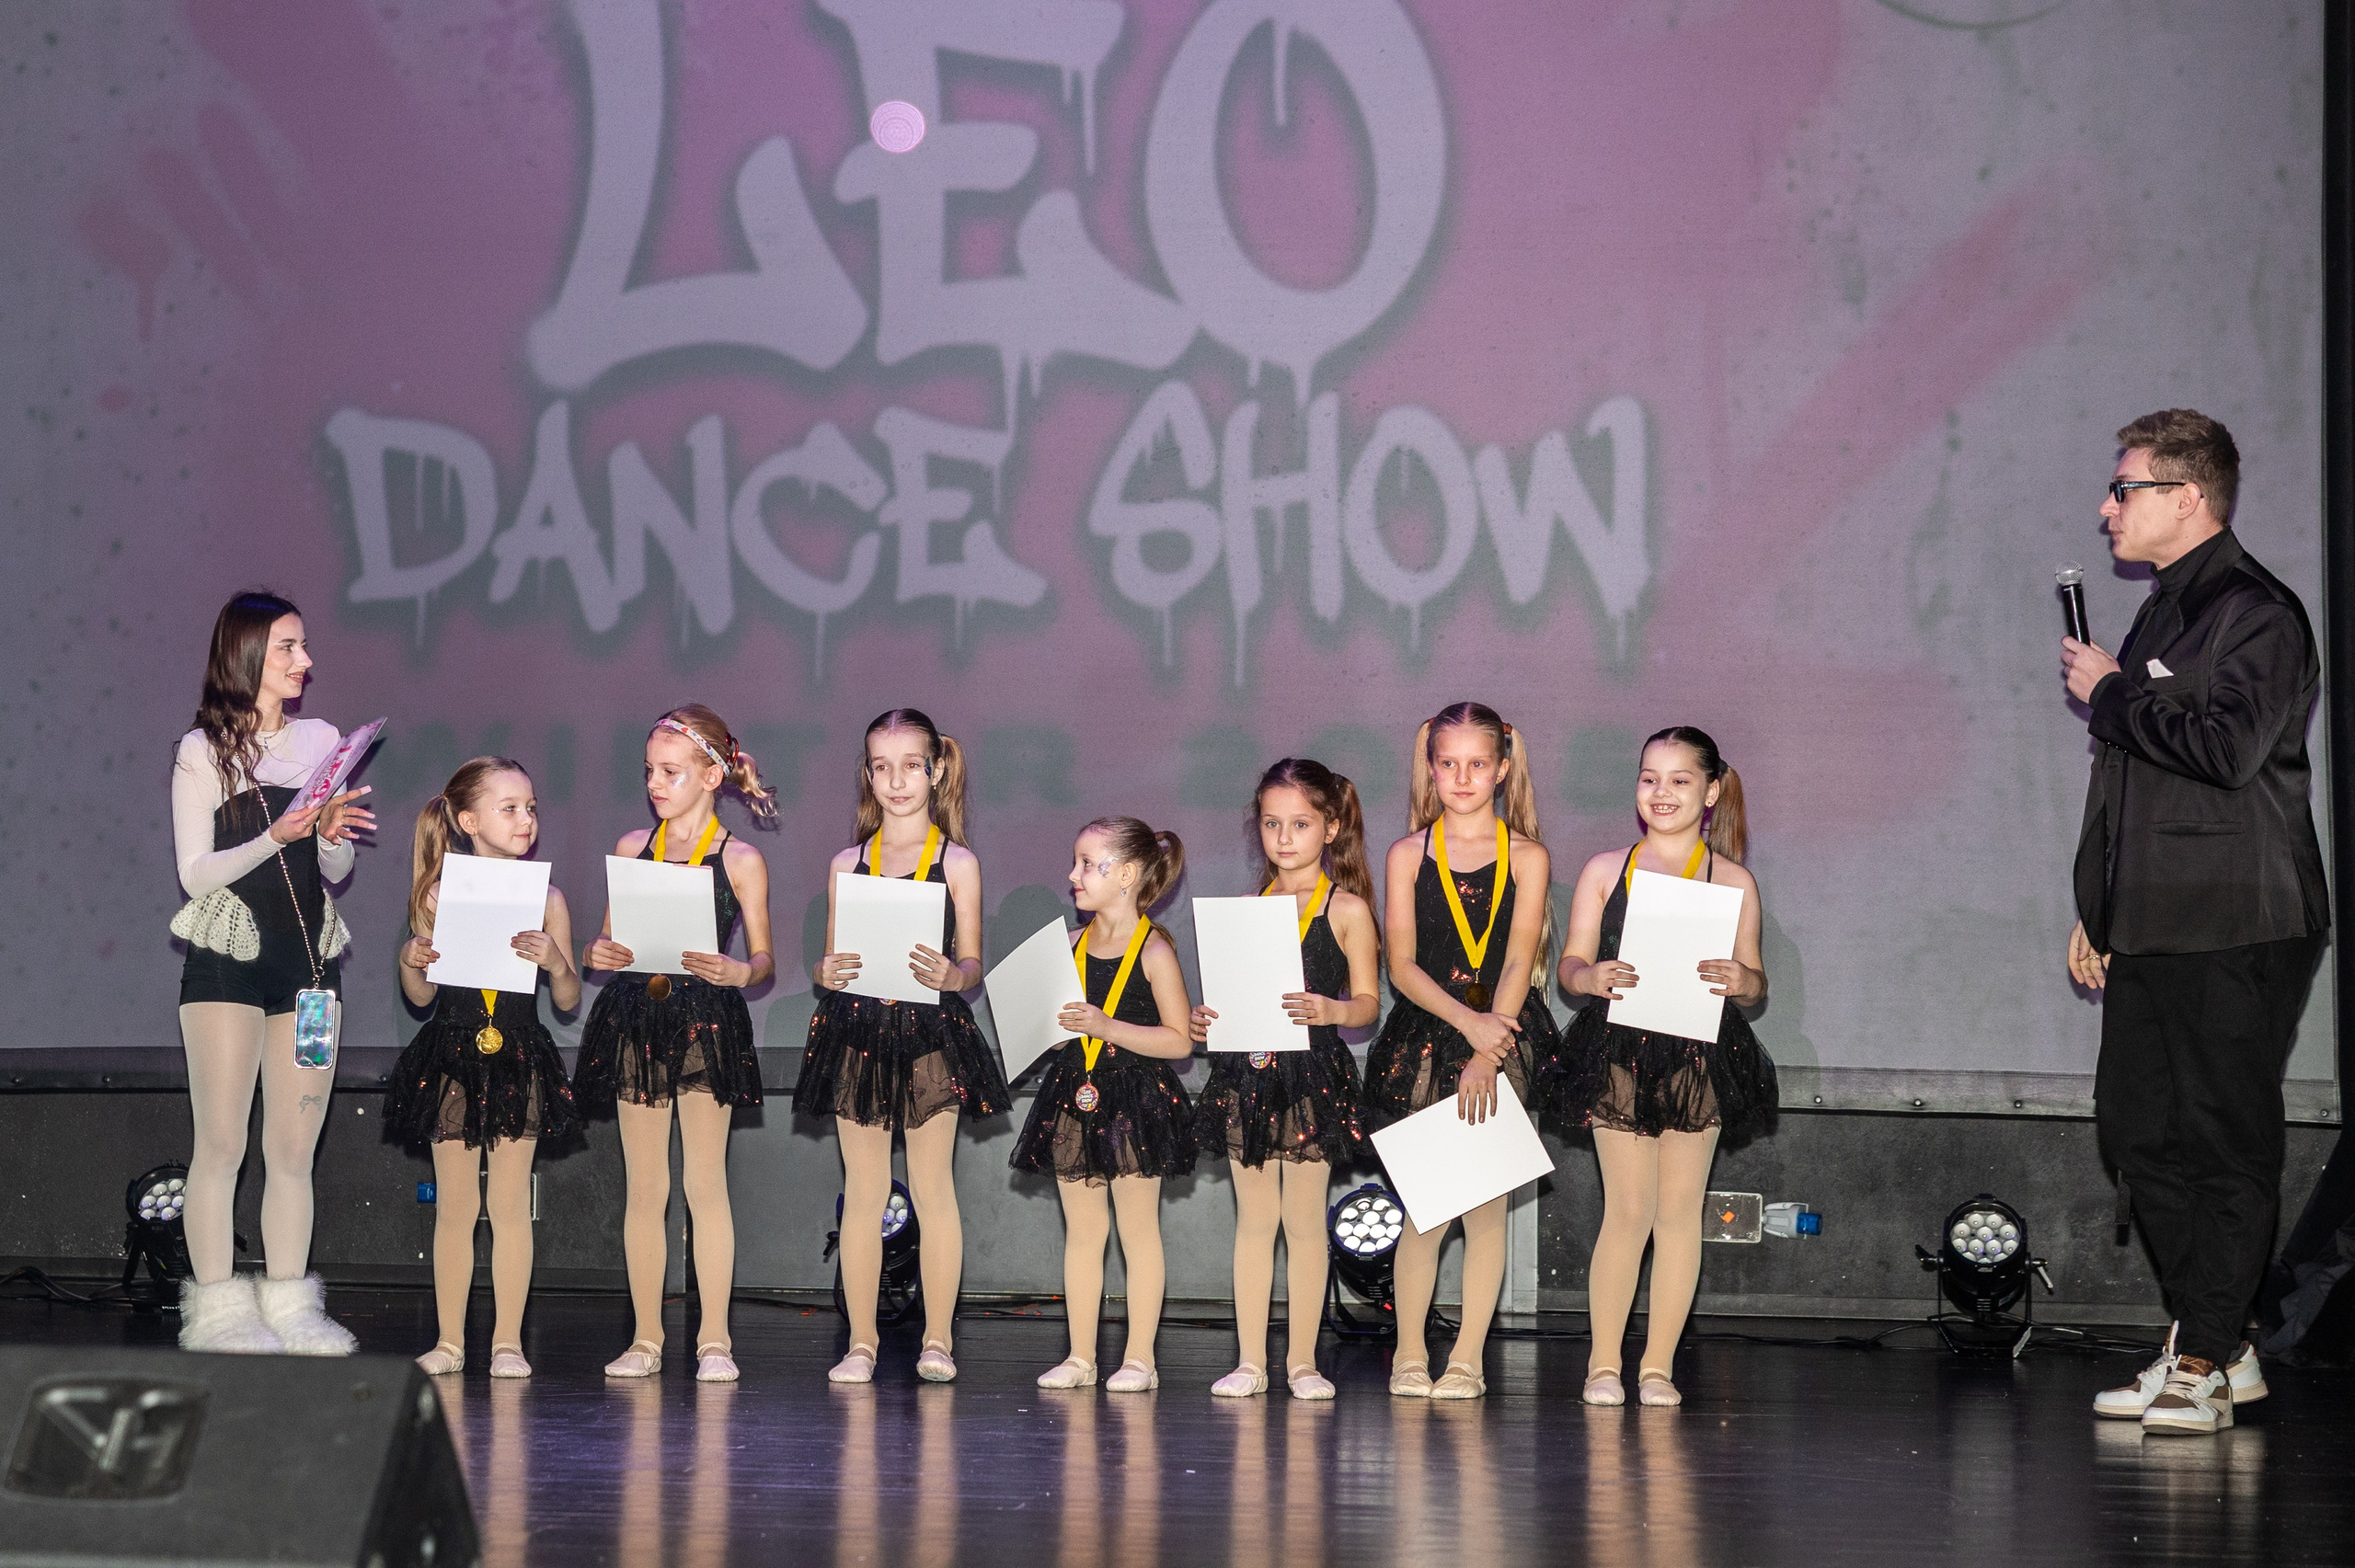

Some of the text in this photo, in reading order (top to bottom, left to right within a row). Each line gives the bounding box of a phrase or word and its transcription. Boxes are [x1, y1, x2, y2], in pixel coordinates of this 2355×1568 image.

[528, 0, 1445, 386] LEO
[326, 382, 1652, 639] DANCE SHOW
